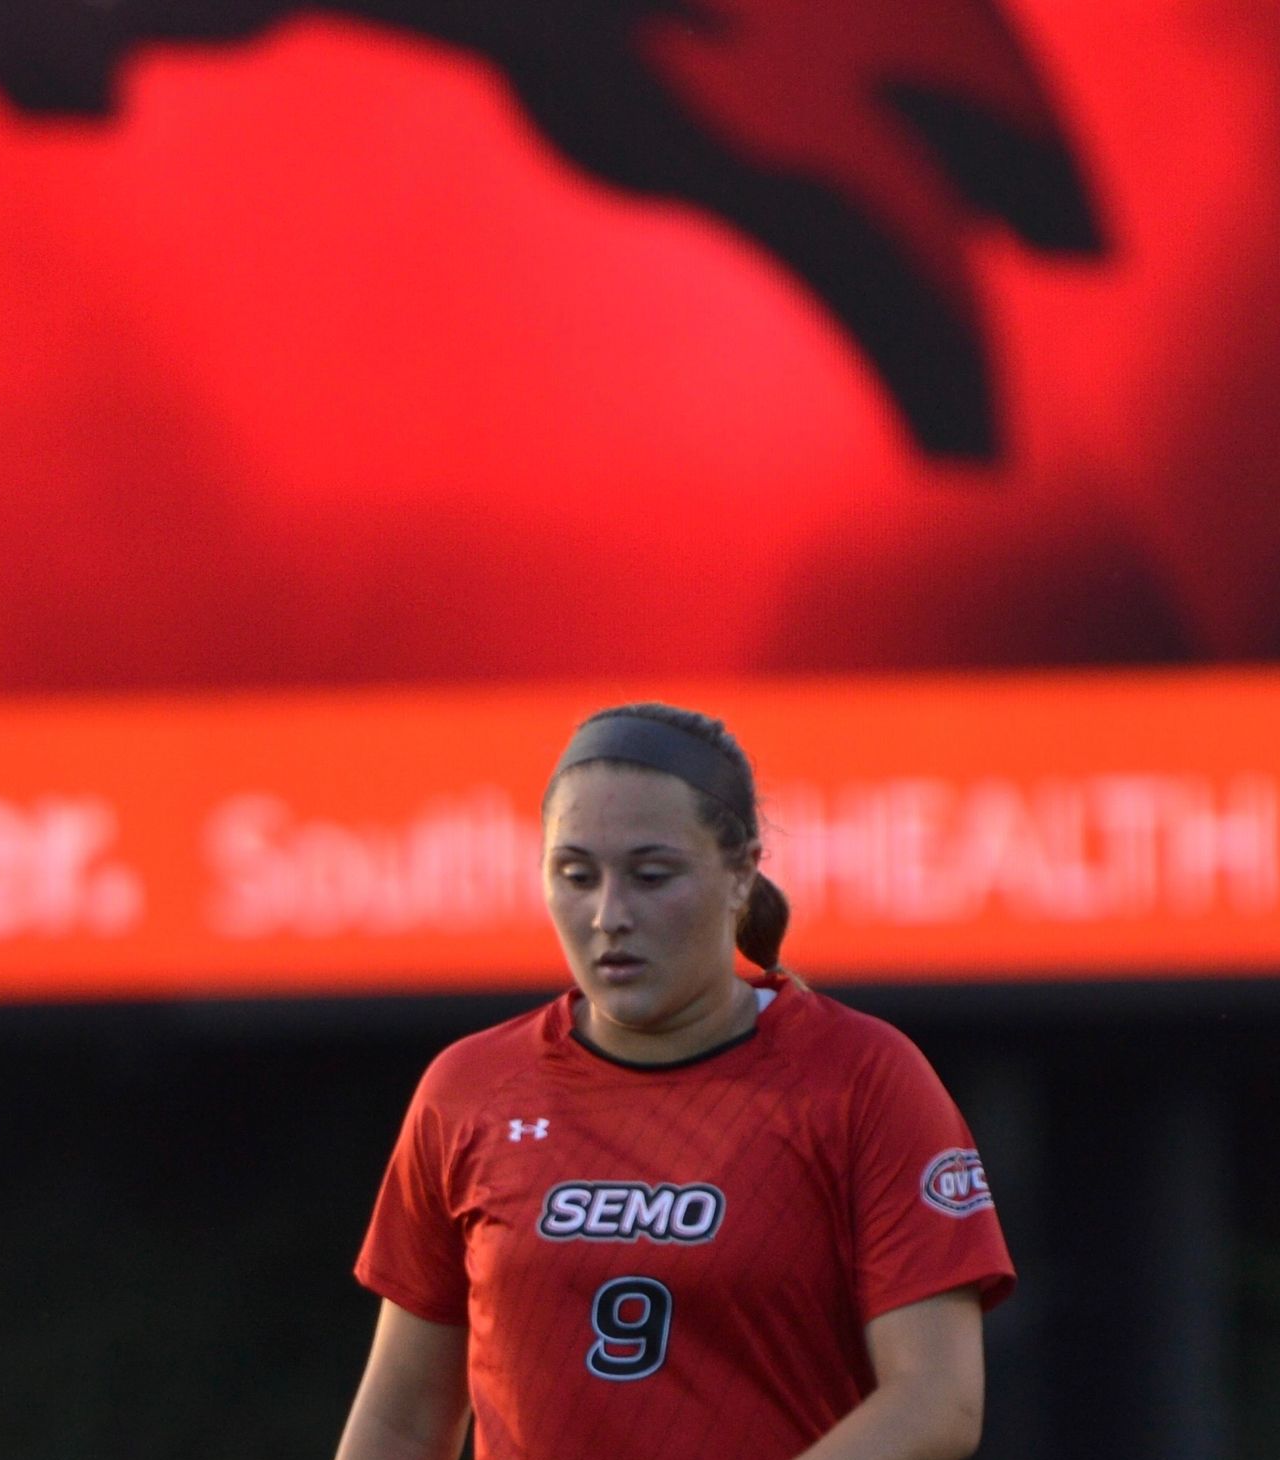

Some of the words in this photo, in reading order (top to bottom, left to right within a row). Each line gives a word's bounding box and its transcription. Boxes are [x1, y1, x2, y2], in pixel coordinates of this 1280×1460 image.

[940, 1166, 989, 1198] OVC
[540, 1183, 723, 1242] SEMO
[586, 1276, 672, 1380] 9
